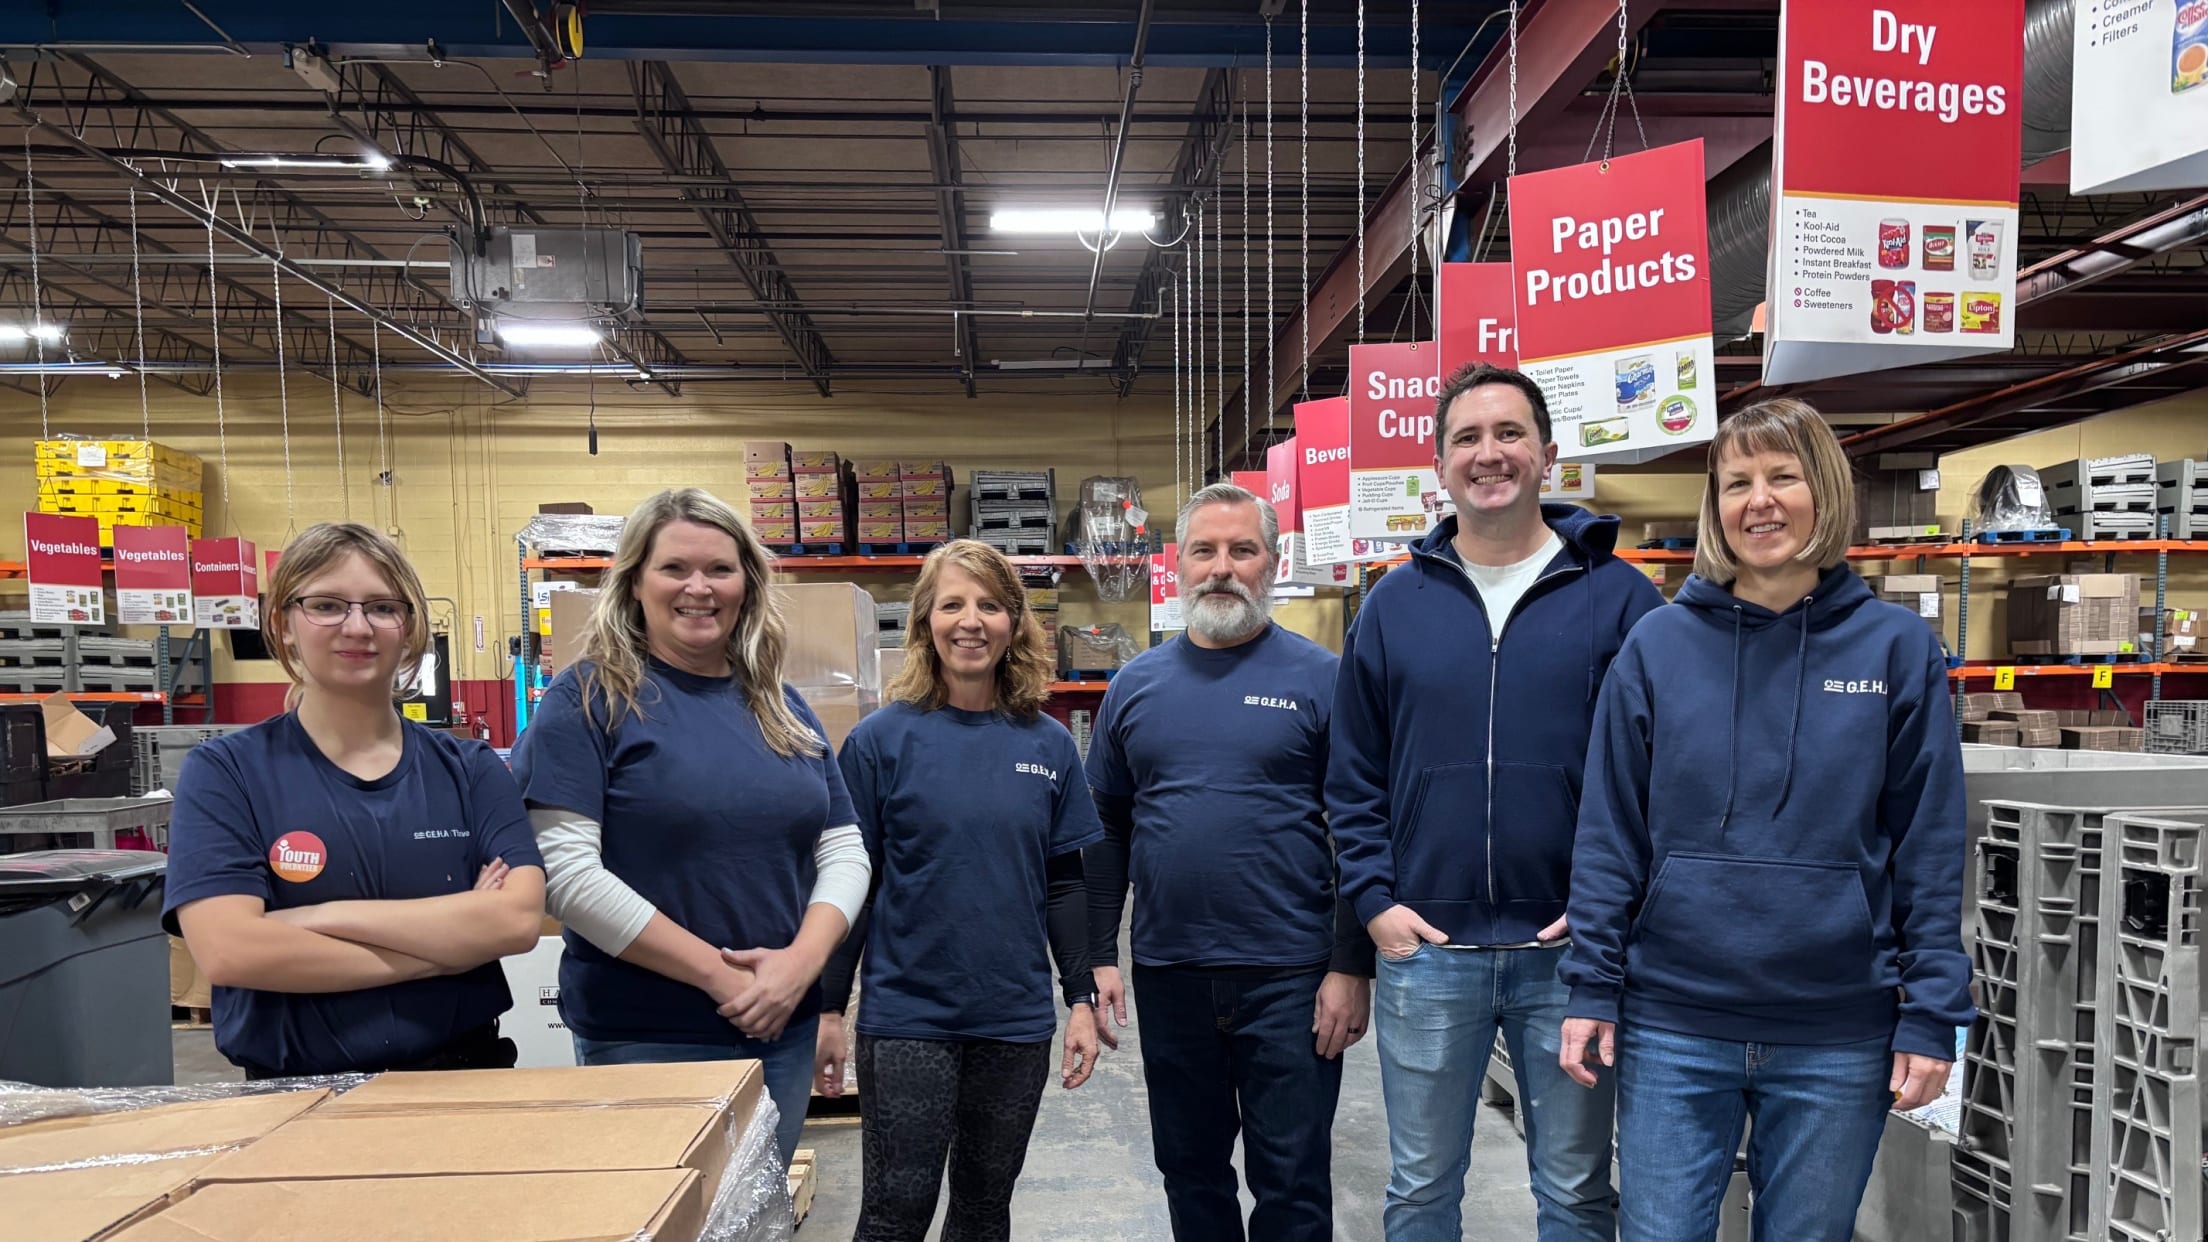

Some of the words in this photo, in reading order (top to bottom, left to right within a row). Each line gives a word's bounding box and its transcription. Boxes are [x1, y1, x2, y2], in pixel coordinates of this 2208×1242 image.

[2103, 0, 2154, 27] Creamer
[1872, 9, 1937, 65] Dry
[2102, 23, 2138, 45] Filters
[1803, 60, 2006, 123] Beverages
[1803, 209, 1817, 218] Tea
[1552, 208, 1664, 255] Paper
[1803, 221, 1840, 231] Kool-Aid
[1803, 234, 1818, 242] Hot
[1820, 234, 1846, 244] Cocoa
[1803, 246, 1845, 256] Powdered
[1847, 248, 1865, 257] Milk
[1803, 258, 1831, 268] Instant
[1833, 259, 1872, 269] Breakfast
[1526, 251, 1696, 306] Products
[1803, 270, 1832, 280] Protein
[1834, 271, 1870, 281] Powders
[1804, 288, 1831, 297] Coffee
[1804, 300, 1853, 310] Sweeteners
[1968, 304, 1993, 313] Lipton
[1555, 366, 1574, 374] Paper
[1556, 373, 1580, 382] Towels
[1558, 381, 1585, 390] Napkins
[1271, 480, 1290, 504] Soda
[31, 539, 98, 556] Vegetables
[118, 549, 185, 563] Vegetables
[195, 561, 240, 573] Containers
[2002, 672, 2009, 683] F
[2100, 670, 2107, 682] F
[277, 844, 321, 865] YOUTH
